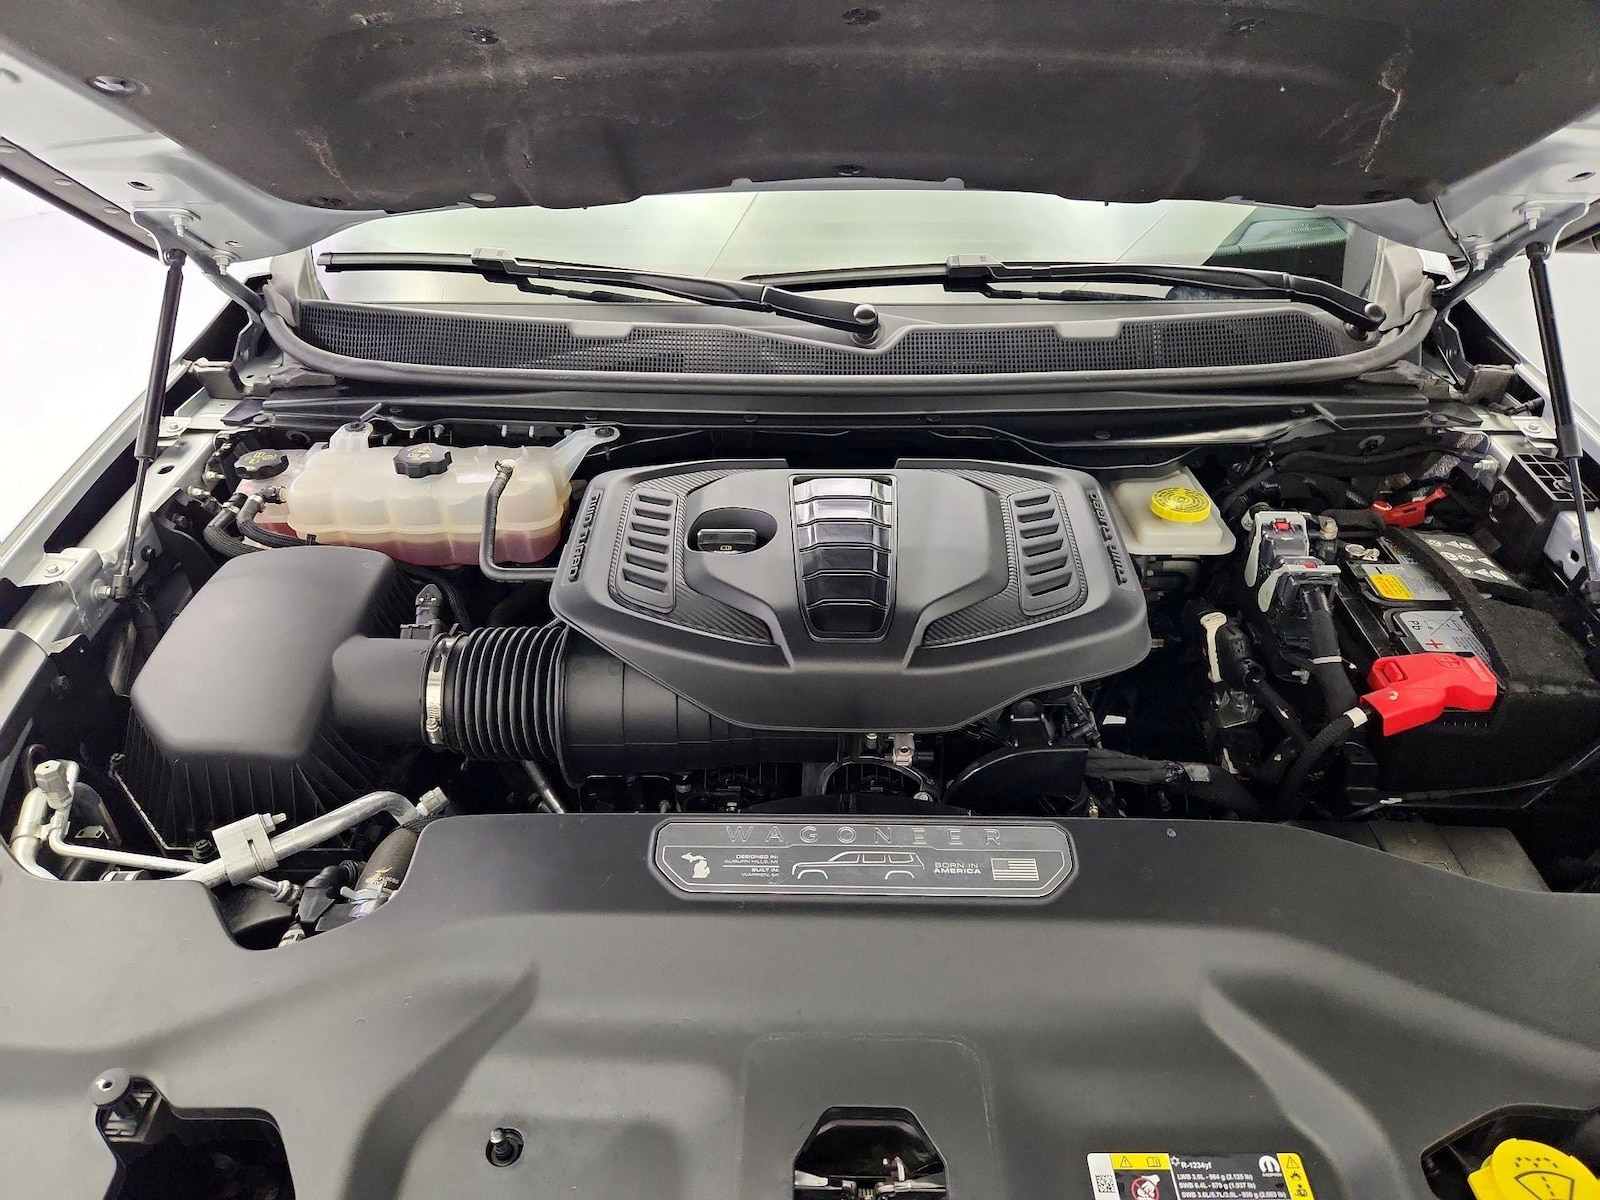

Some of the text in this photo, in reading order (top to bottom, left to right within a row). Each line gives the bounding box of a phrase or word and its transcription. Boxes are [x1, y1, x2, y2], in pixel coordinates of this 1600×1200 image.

[567, 526, 591, 582] TURBO
[1088, 490, 1128, 586] TWIN TURBO
[725, 826, 1002, 846] WAGONEER
[1181, 1161, 1212, 1170] R-1234yf
